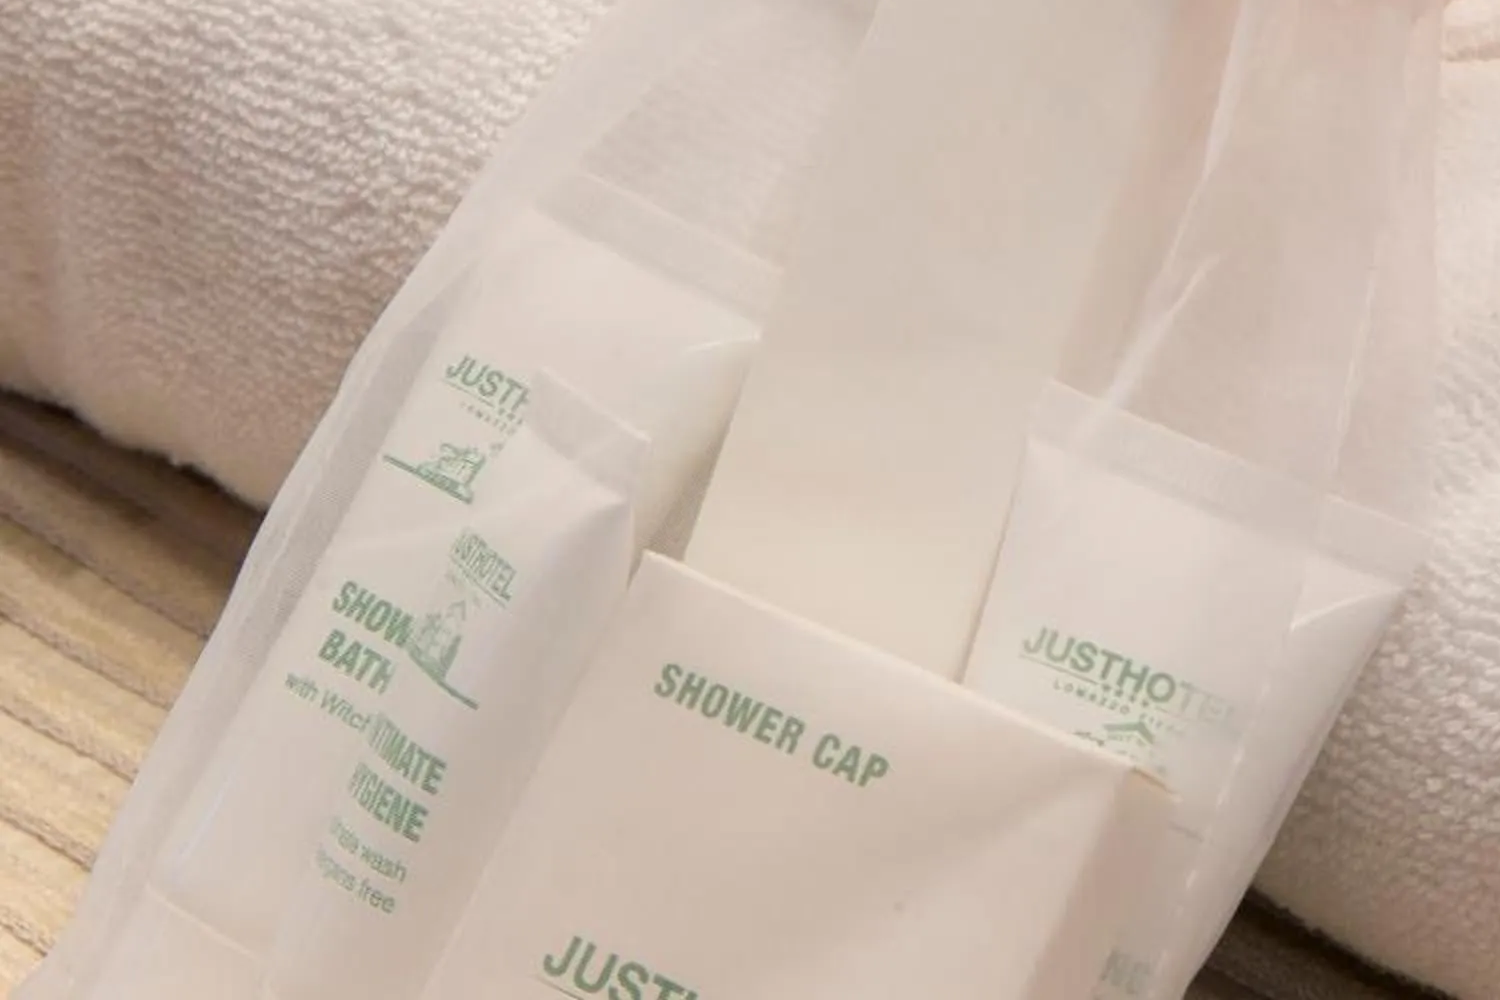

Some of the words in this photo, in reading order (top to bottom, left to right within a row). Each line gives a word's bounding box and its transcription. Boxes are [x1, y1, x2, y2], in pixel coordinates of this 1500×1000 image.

[653, 663, 806, 755] SHOWER
[812, 733, 890, 788] CAP
[543, 935, 699, 1000] JUST
